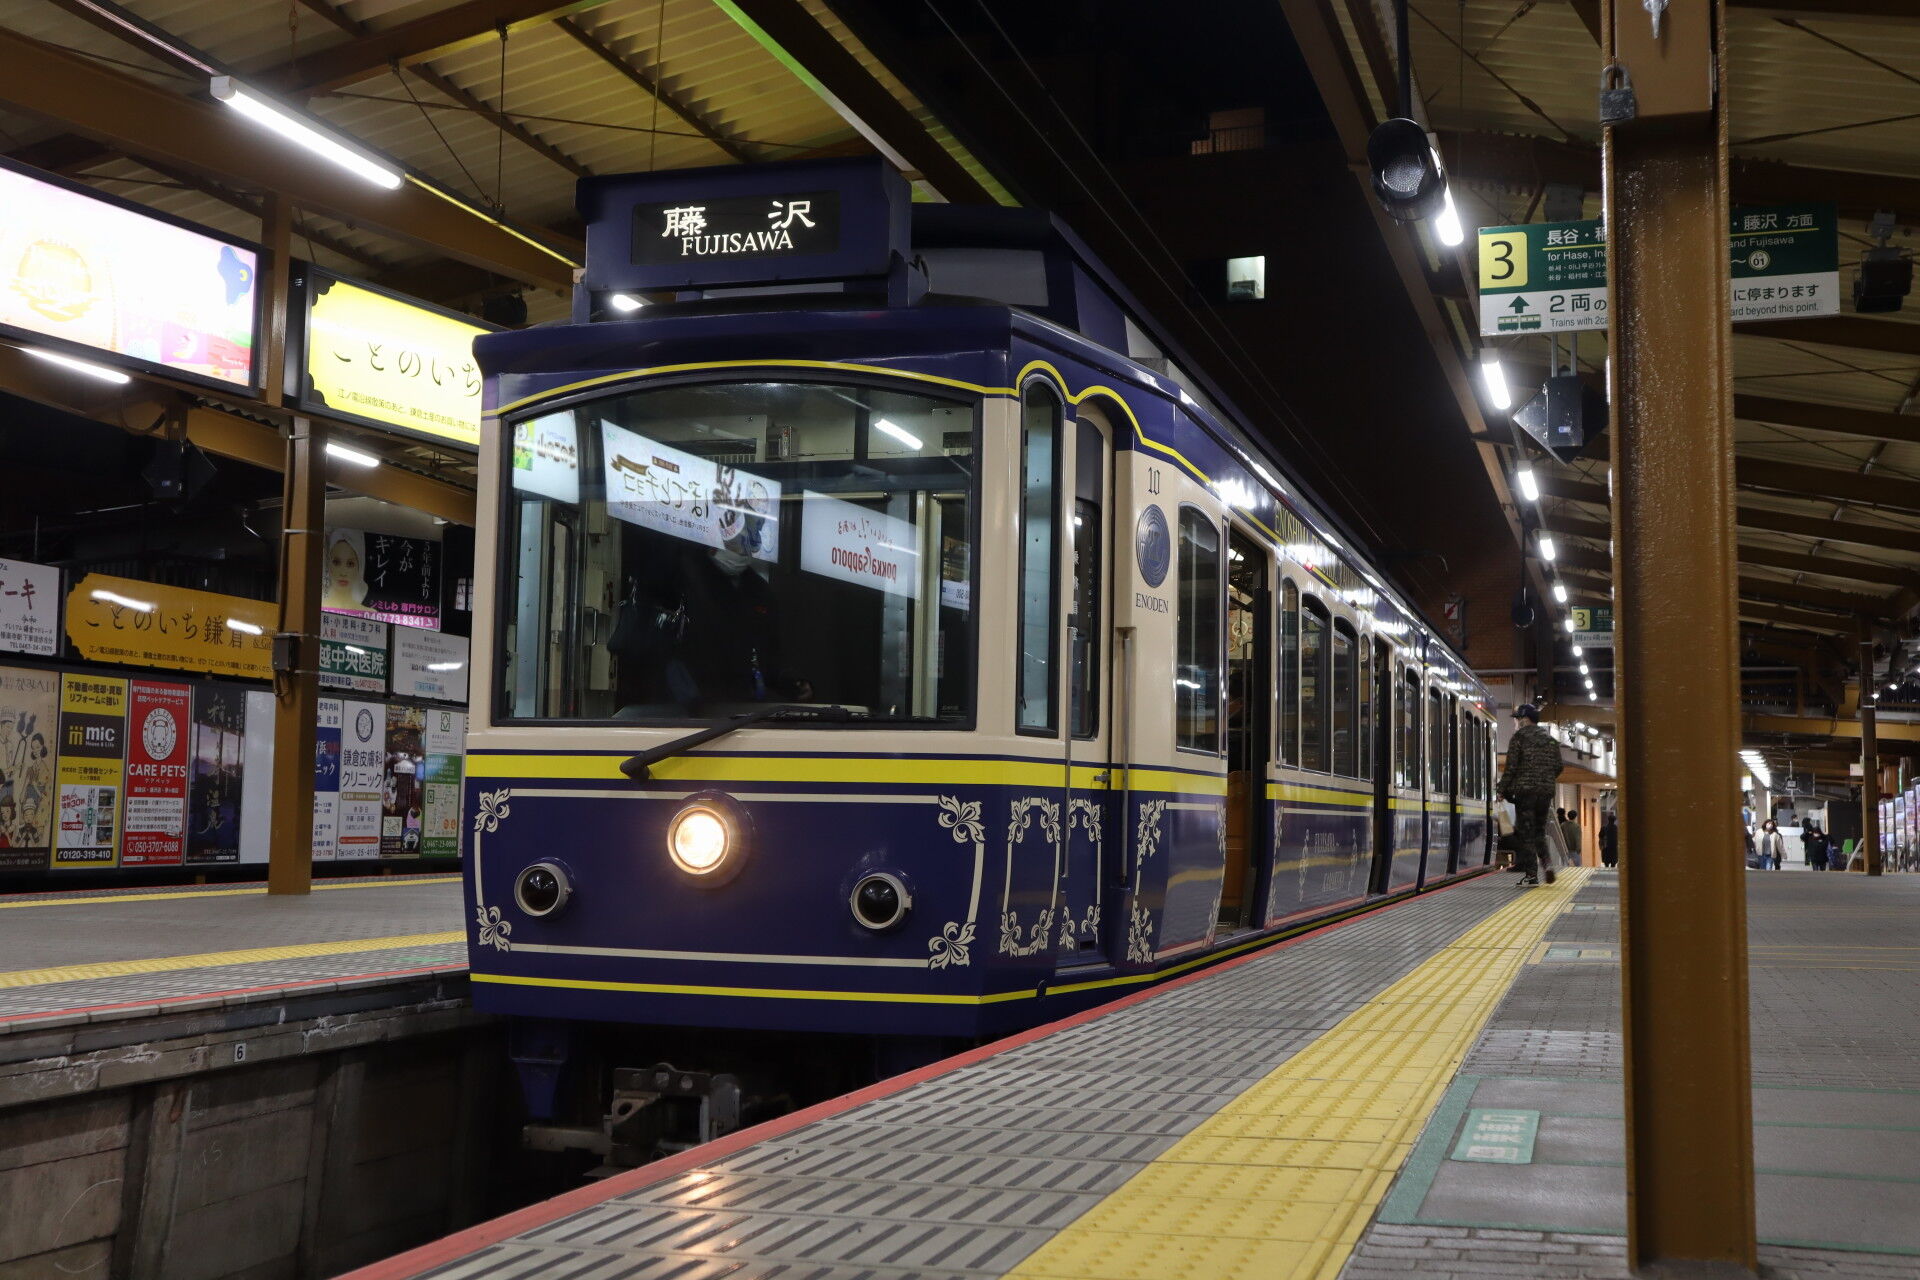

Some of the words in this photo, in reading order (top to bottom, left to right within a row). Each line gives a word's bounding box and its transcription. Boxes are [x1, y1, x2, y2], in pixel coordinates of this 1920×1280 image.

[1786, 214, 1814, 227] 方面
[681, 230, 794, 255] FUJISAWA
[1547, 252, 1561, 261] for
[1563, 251, 1591, 261] Hase,
[1749, 236, 1795, 247] Fujisawa
[1491, 240, 1515, 280] 3
[1753, 258, 1764, 266] 01
[1734, 284, 1819, 301] に停まります
[1550, 317, 1576, 327] Trains
[1577, 316, 1592, 326] with
[1746, 305, 1776, 317] beyond
[1778, 303, 1794, 313] this
[1148, 467, 1160, 495] 10
[375, 535, 390, 588] キレイ
[400, 539, 415, 573] 今が
[401, 603, 439, 615] 専門サロン
[1136, 593, 1169, 614] ENODEN
[390, 614, 401, 624] 73
[402, 615, 424, 626] 8341
[1576, 612, 1586, 628] 3
[85, 726, 115, 743] mic
[343, 749, 383, 769] 鎌倉皮膚科
[128, 764, 158, 776] CARE
[160, 765, 186, 777] PETS
[342, 772, 382, 788] クリニック
[63, 850, 111, 860] 0120-319-410
[236, 1046, 243, 1060] 6
